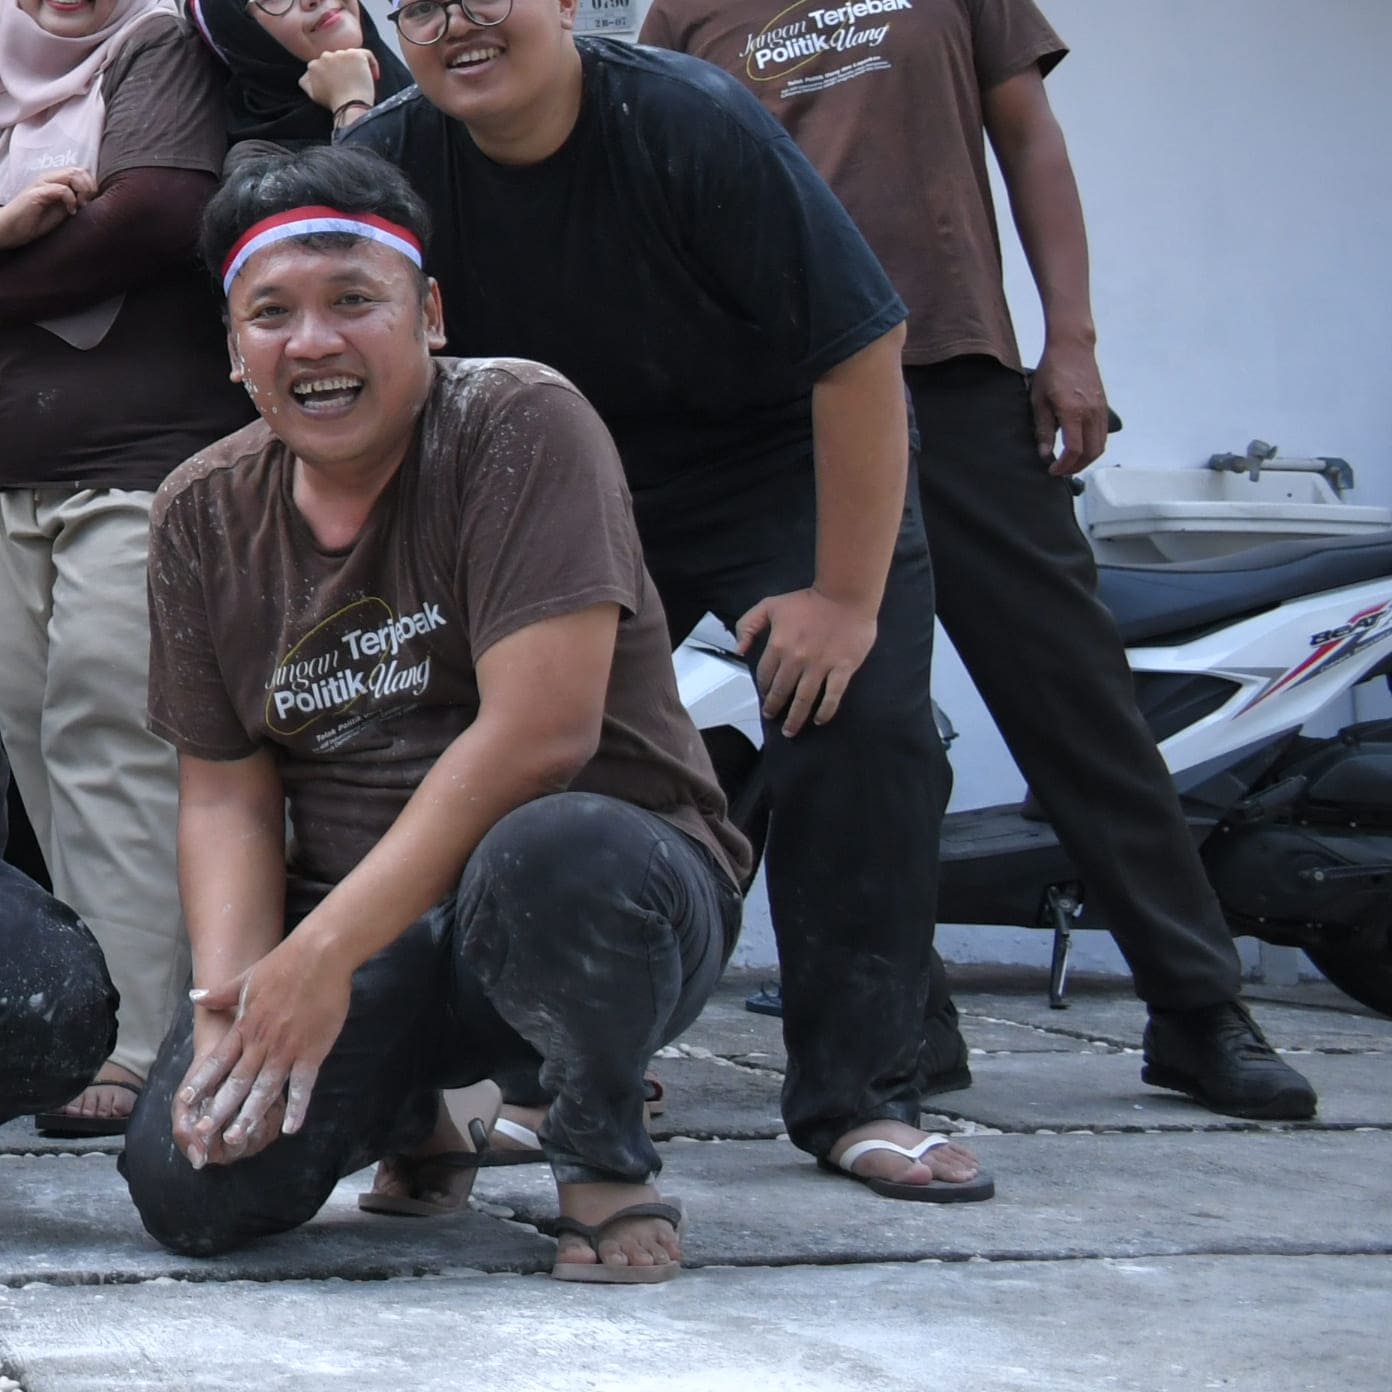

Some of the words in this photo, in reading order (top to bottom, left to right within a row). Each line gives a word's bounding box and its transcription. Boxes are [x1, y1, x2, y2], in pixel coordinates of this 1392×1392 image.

[738, 19, 808, 57] Jangan
[754, 31, 830, 70] Politik
[829, 24, 890, 52] Uang
[273, 668, 369, 720] Politik
[368, 659, 431, 699] Uang
